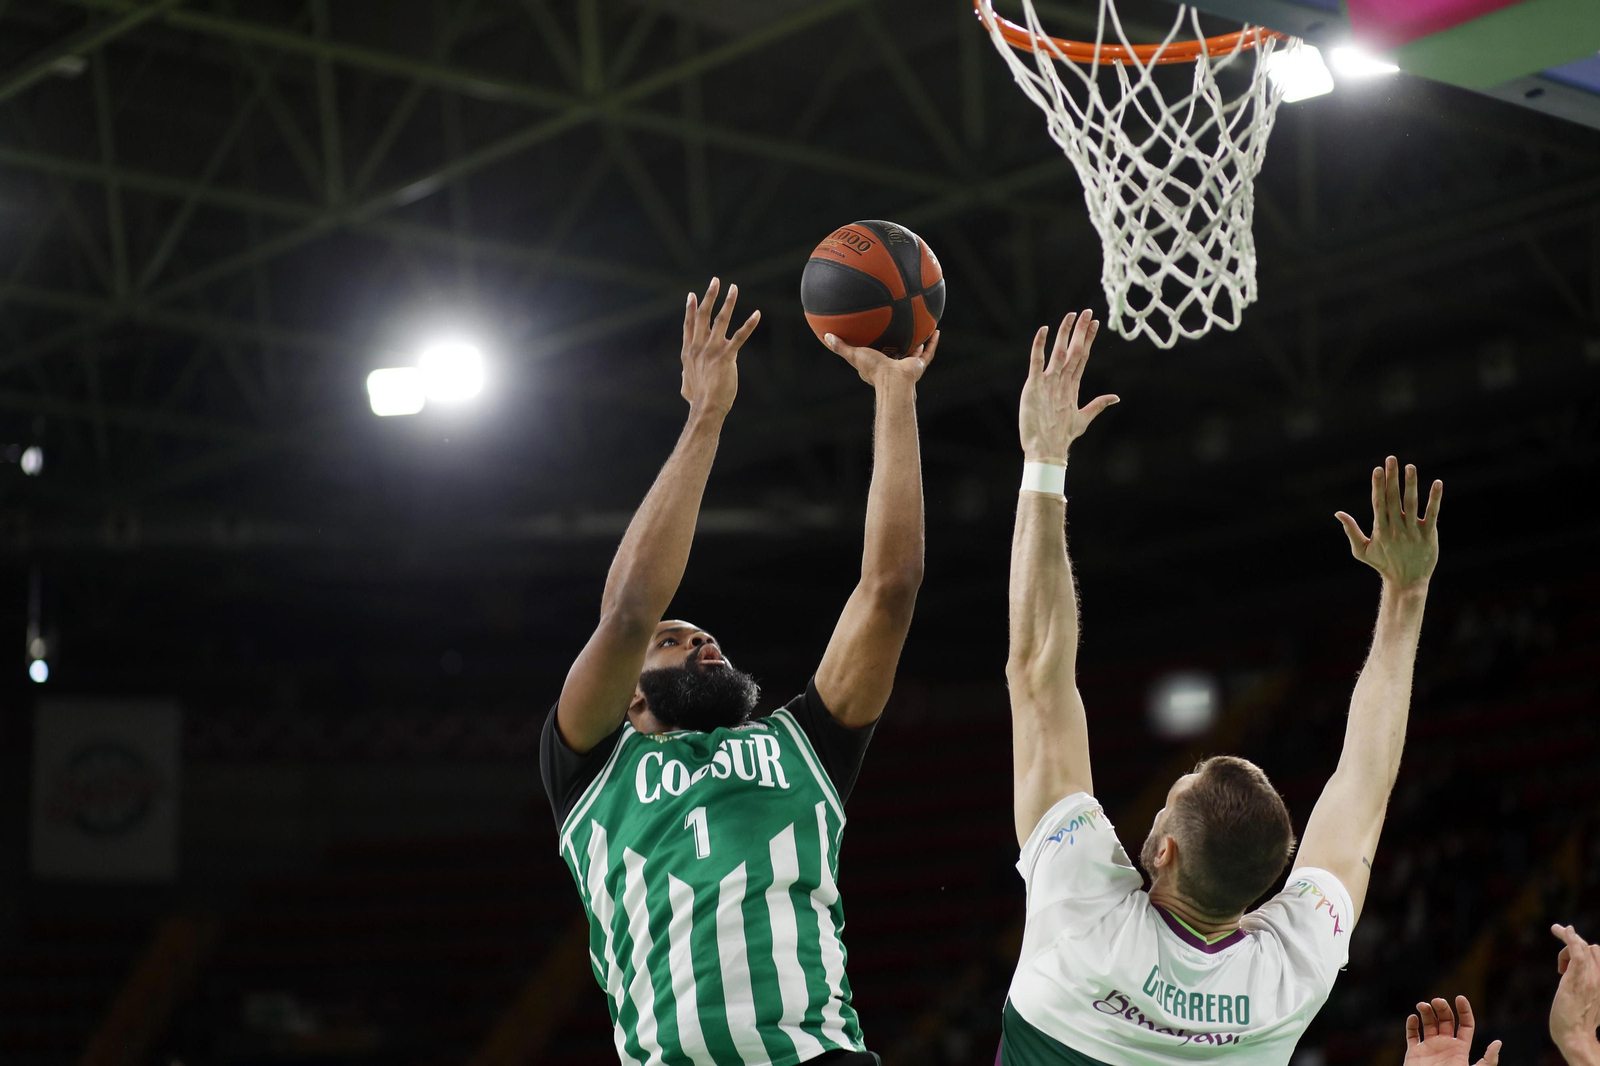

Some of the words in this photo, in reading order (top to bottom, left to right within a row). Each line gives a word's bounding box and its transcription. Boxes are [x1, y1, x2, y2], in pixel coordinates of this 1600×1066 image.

[684, 806, 711, 860] 1
[1092, 989, 1253, 1046] Benahav
[1142, 964, 1250, 1025] GUERRERO
